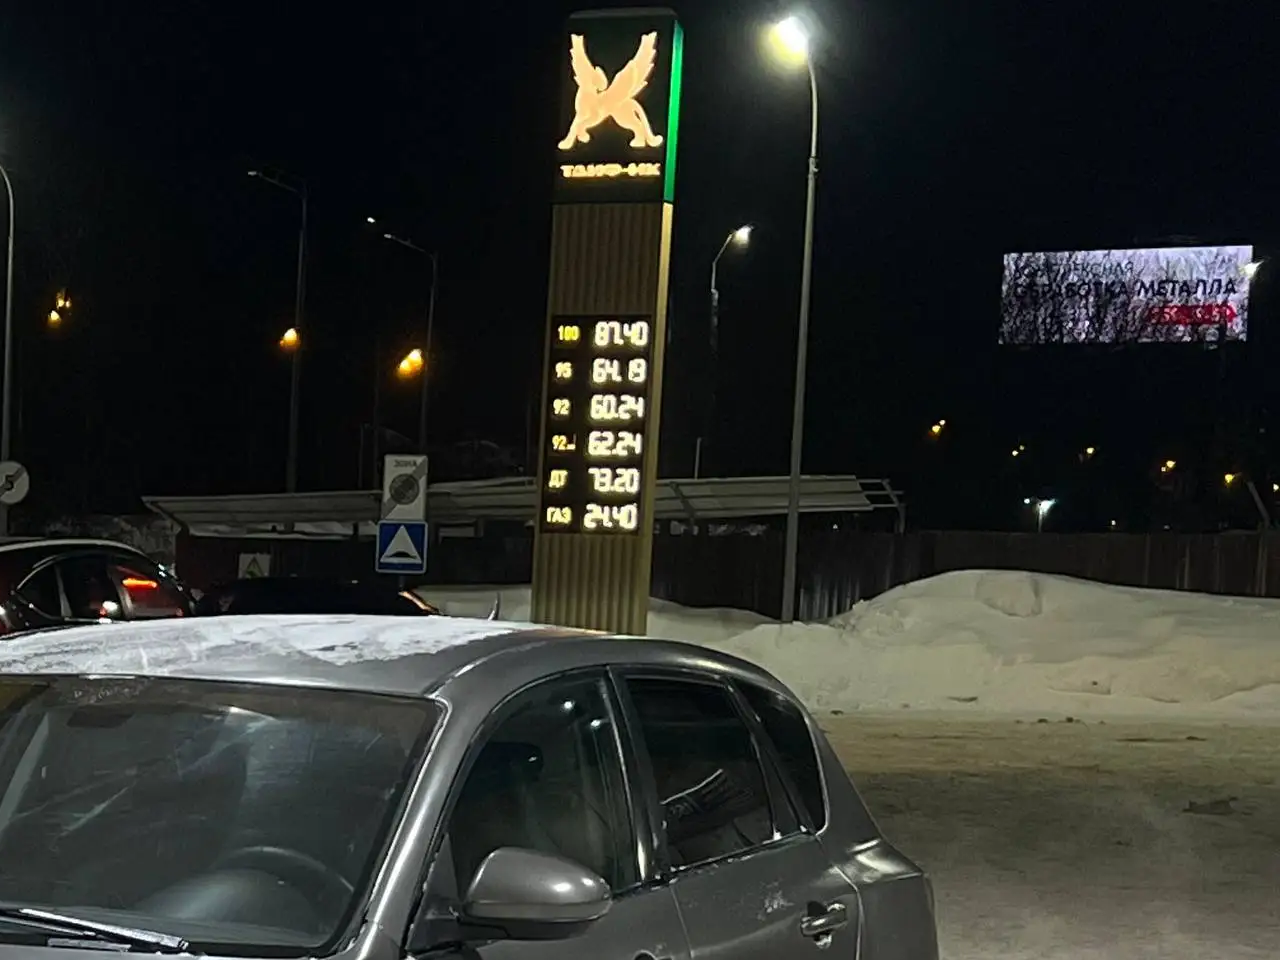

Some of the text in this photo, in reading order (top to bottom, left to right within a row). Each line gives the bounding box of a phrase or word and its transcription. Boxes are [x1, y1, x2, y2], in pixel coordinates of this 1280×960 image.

[1137, 277, 1238, 297] МЕТАЛЛА
[595, 321, 649, 346] 87.40
[553, 399, 570, 415] 92
[3, 474, 14, 491] 5
[546, 507, 572, 524] ГАЗ
